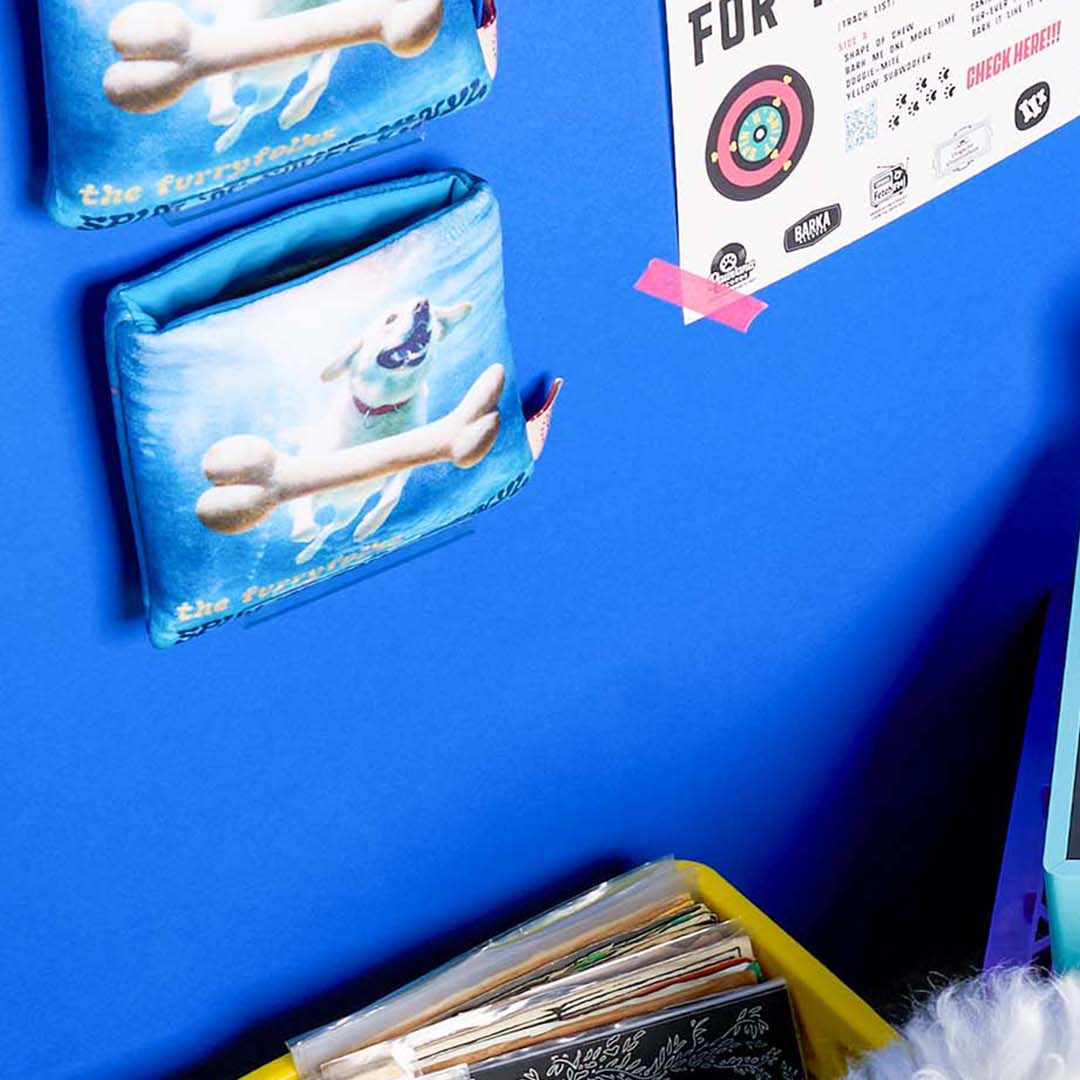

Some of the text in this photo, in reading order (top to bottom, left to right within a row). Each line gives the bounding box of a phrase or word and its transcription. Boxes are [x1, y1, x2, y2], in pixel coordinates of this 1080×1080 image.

[688, 0, 778, 67] FOR
[844, 22, 914, 62] SHAPE OF CHEW
[845, 14, 956, 75] BARK ME ONE MORE TIME
[966, 20, 1062, 90] CHECK HERE!!!
[846, 52, 932, 101] YELLOW SUBWOOFER
[79, 183, 144, 206] the
[157, 128, 338, 196] furryfolks
[794, 210, 832, 243] BARKA
[175, 597, 230, 622] the
